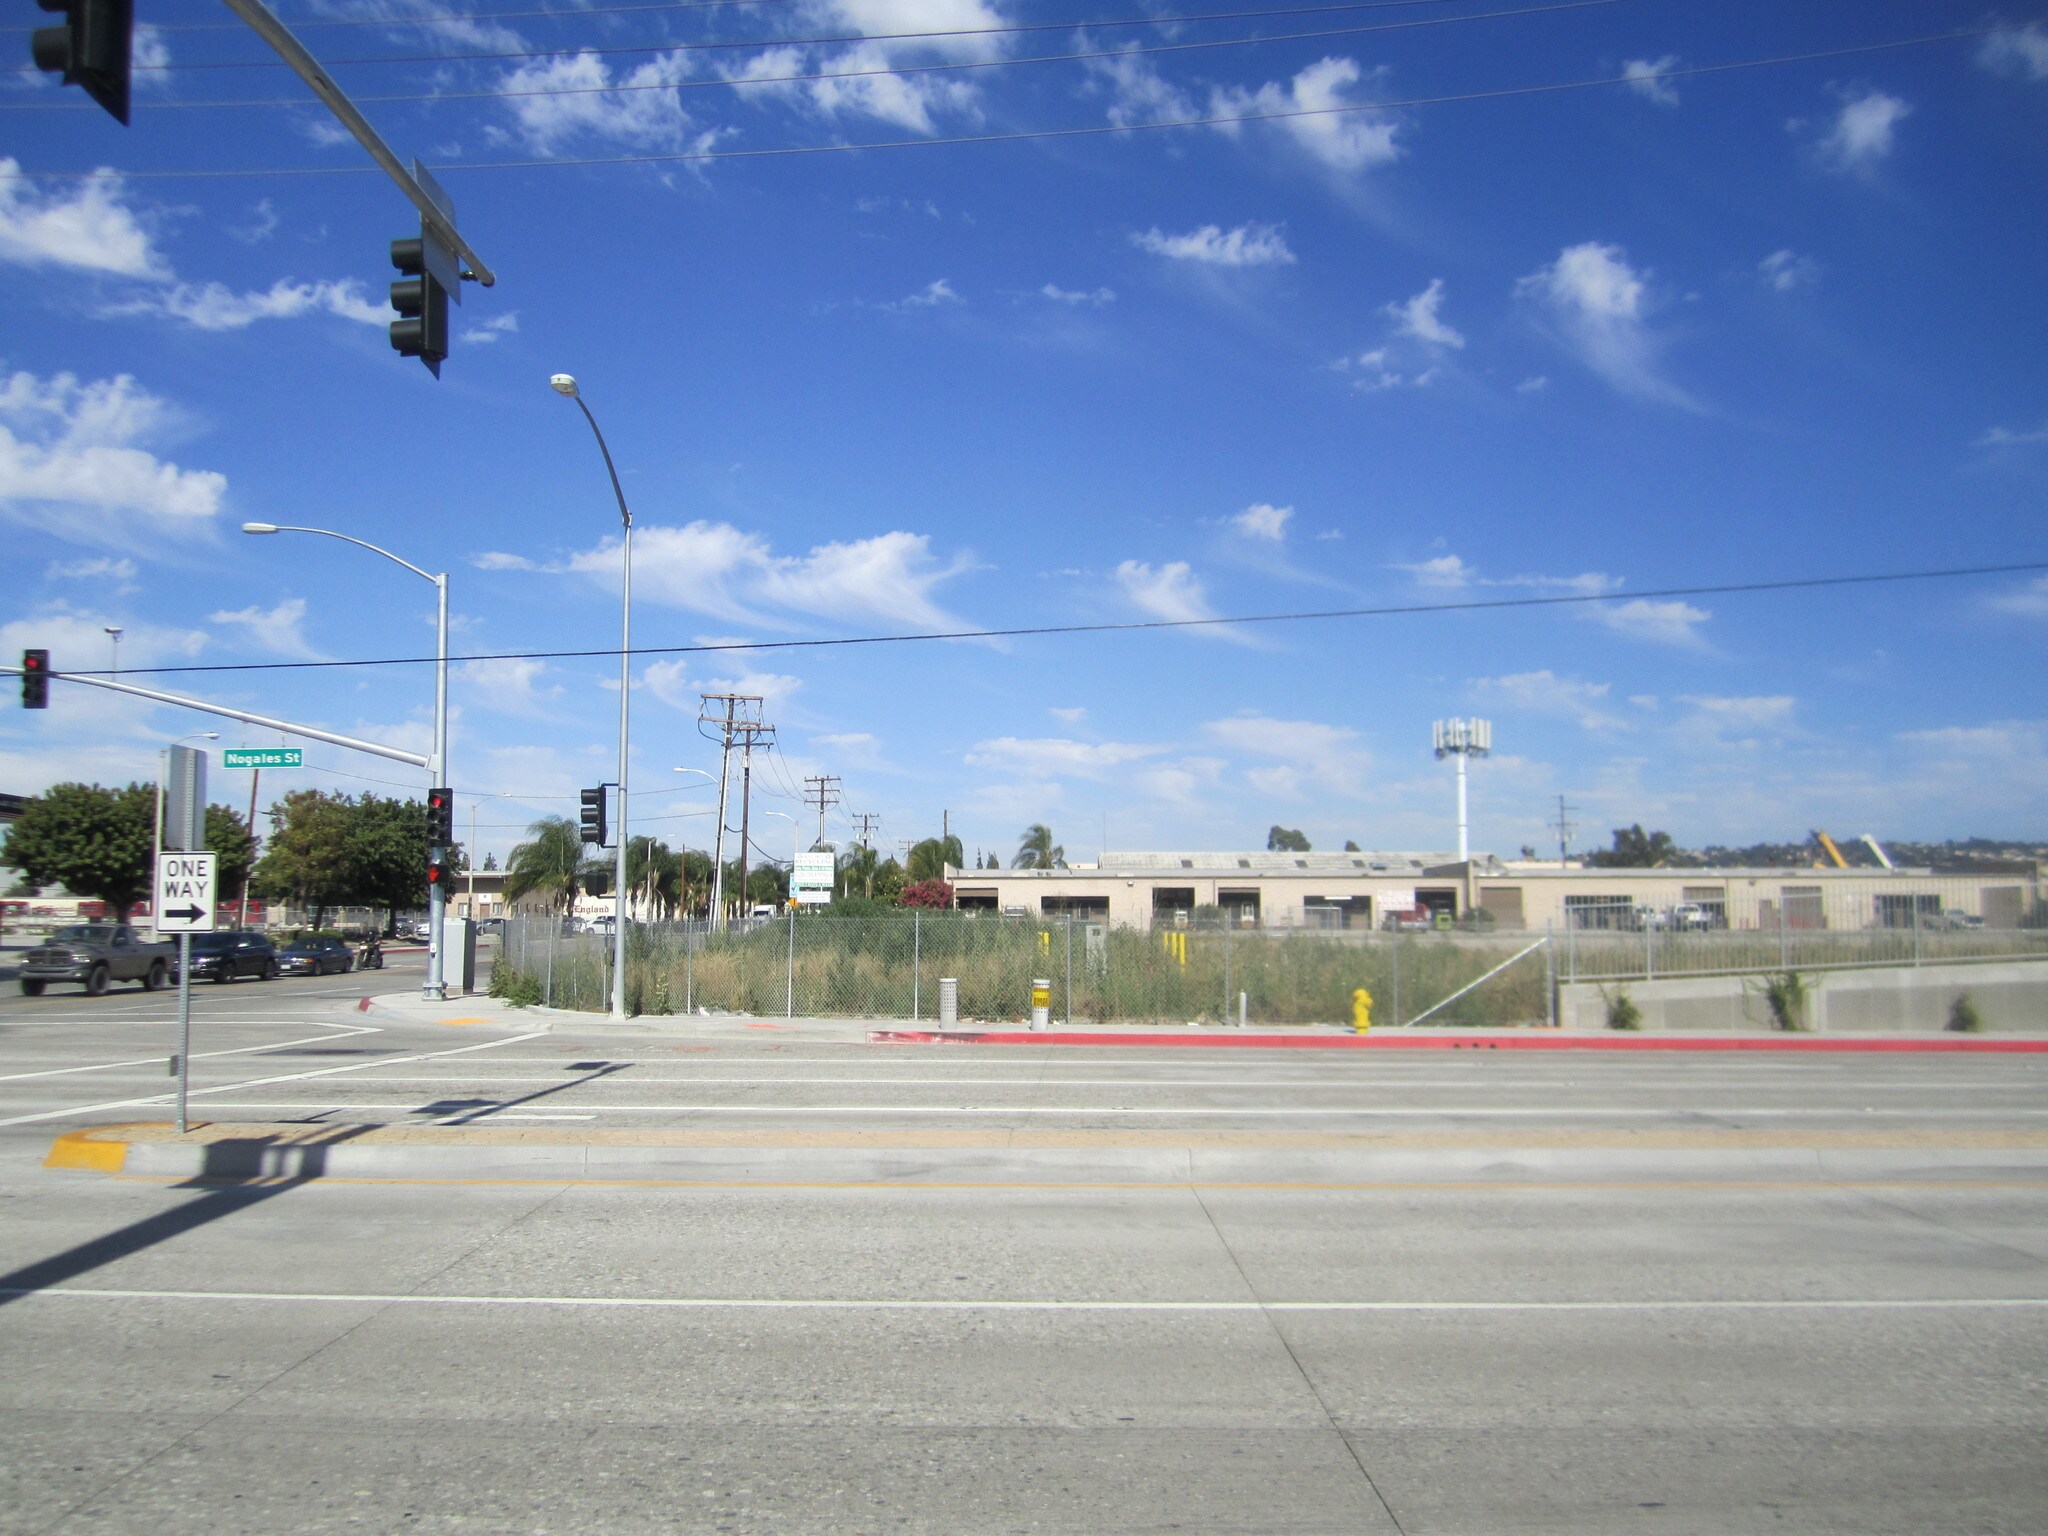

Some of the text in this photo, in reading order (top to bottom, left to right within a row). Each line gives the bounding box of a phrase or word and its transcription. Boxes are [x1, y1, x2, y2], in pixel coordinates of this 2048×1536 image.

[227, 752, 300, 766] Nogales St
[167, 860, 207, 877] ONE
[164, 881, 208, 898] WAY
[574, 905, 610, 914] England
